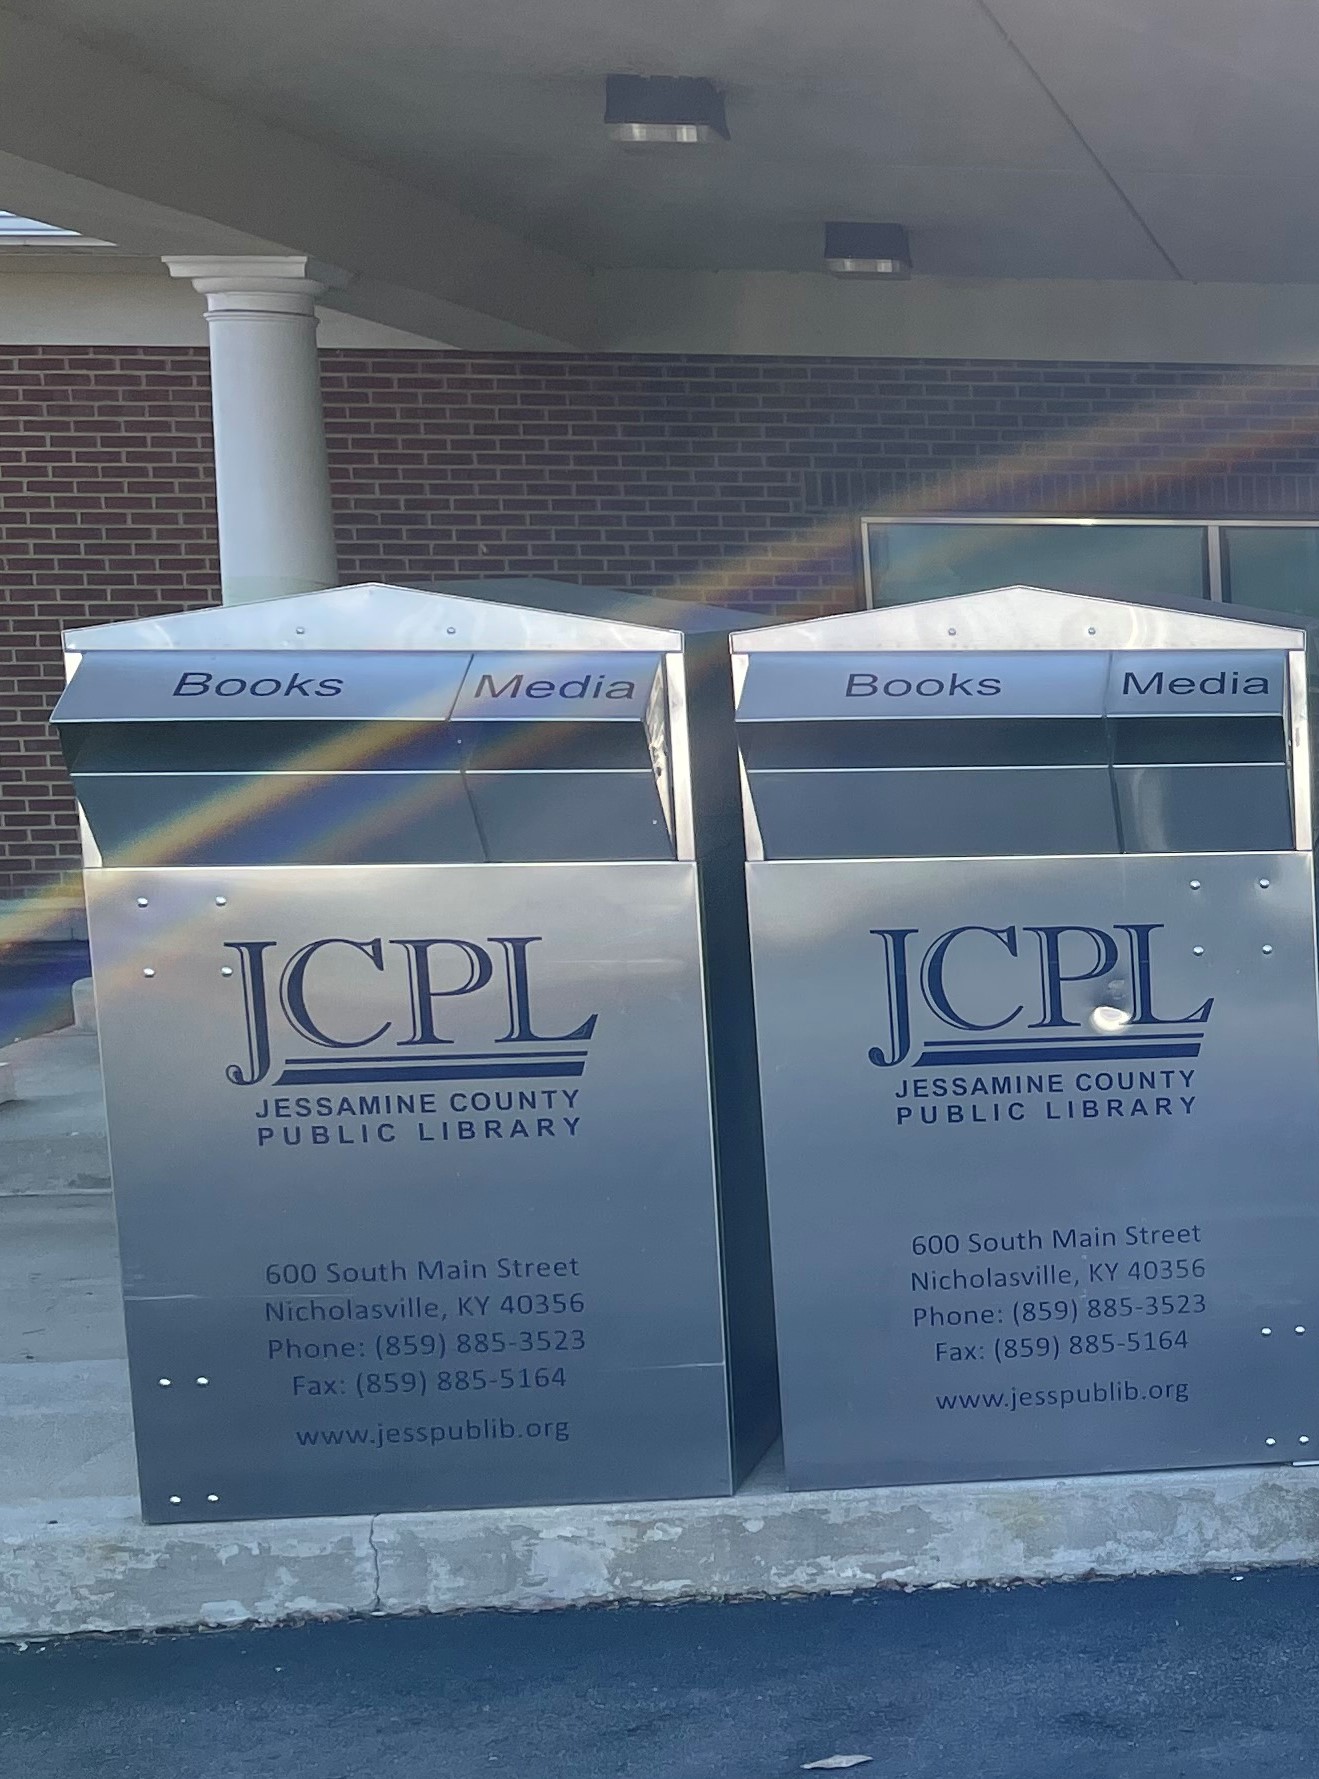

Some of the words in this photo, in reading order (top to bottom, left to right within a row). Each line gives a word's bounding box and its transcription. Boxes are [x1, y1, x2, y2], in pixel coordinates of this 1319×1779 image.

[171, 670, 345, 698] Books
[473, 673, 637, 701] Media
[844, 673, 1002, 698] Books
[1122, 670, 1271, 696] Media
[867, 923, 1215, 1068] JCPL
[224, 935, 599, 1087] JCPL
[895, 1073, 1064, 1099] JESSAMINE
[1075, 1069, 1196, 1093] COUNTY
[255, 1092, 438, 1119] JESSAMINE
[449, 1088, 580, 1113] COUNTY
[895, 1101, 1026, 1126] PUBLIC
[1046, 1096, 1197, 1121] LIBRARY
[257, 1121, 397, 1147] PUBLIC
[418, 1116, 582, 1140] LIBRARY
[911, 1234, 960, 1256] 600
[968, 1229, 1044, 1254] South
[1052, 1226, 1117, 1250] Main
[1125, 1224, 1201, 1247] Street
[265, 1262, 318, 1285] 600
[326, 1259, 408, 1284] South
[417, 1258, 488, 1282] Main
[497, 1256, 580, 1279] Street
[910, 1265, 1080, 1293] Nicholasville,
[1089, 1262, 1120, 1284] KY
[1127, 1258, 1206, 1281] 40356
[265, 1297, 448, 1323] Nicholasville,
[458, 1295, 490, 1317] KY
[500, 1293, 585, 1316] 40356
[913, 1303, 1003, 1329] Phone:
[1012, 1300, 1080, 1326] (859)
[1087, 1294, 1207, 1320] 885-3523
[268, 1336, 366, 1360] Phone:
[374, 1333, 447, 1358] (859)
[456, 1330, 587, 1354] 885-3523
[935, 1340, 986, 1363] Fax:
[994, 1335, 1060, 1361] (859)
[1068, 1330, 1189, 1356] 885-5164
[293, 1374, 346, 1397] Fax:
[354, 1371, 428, 1396] (859)
[437, 1367, 567, 1392] 885-5164
[935, 1381, 1189, 1411] www.jesspublib.org
[296, 1418, 570, 1448] www.jesspublib.org
